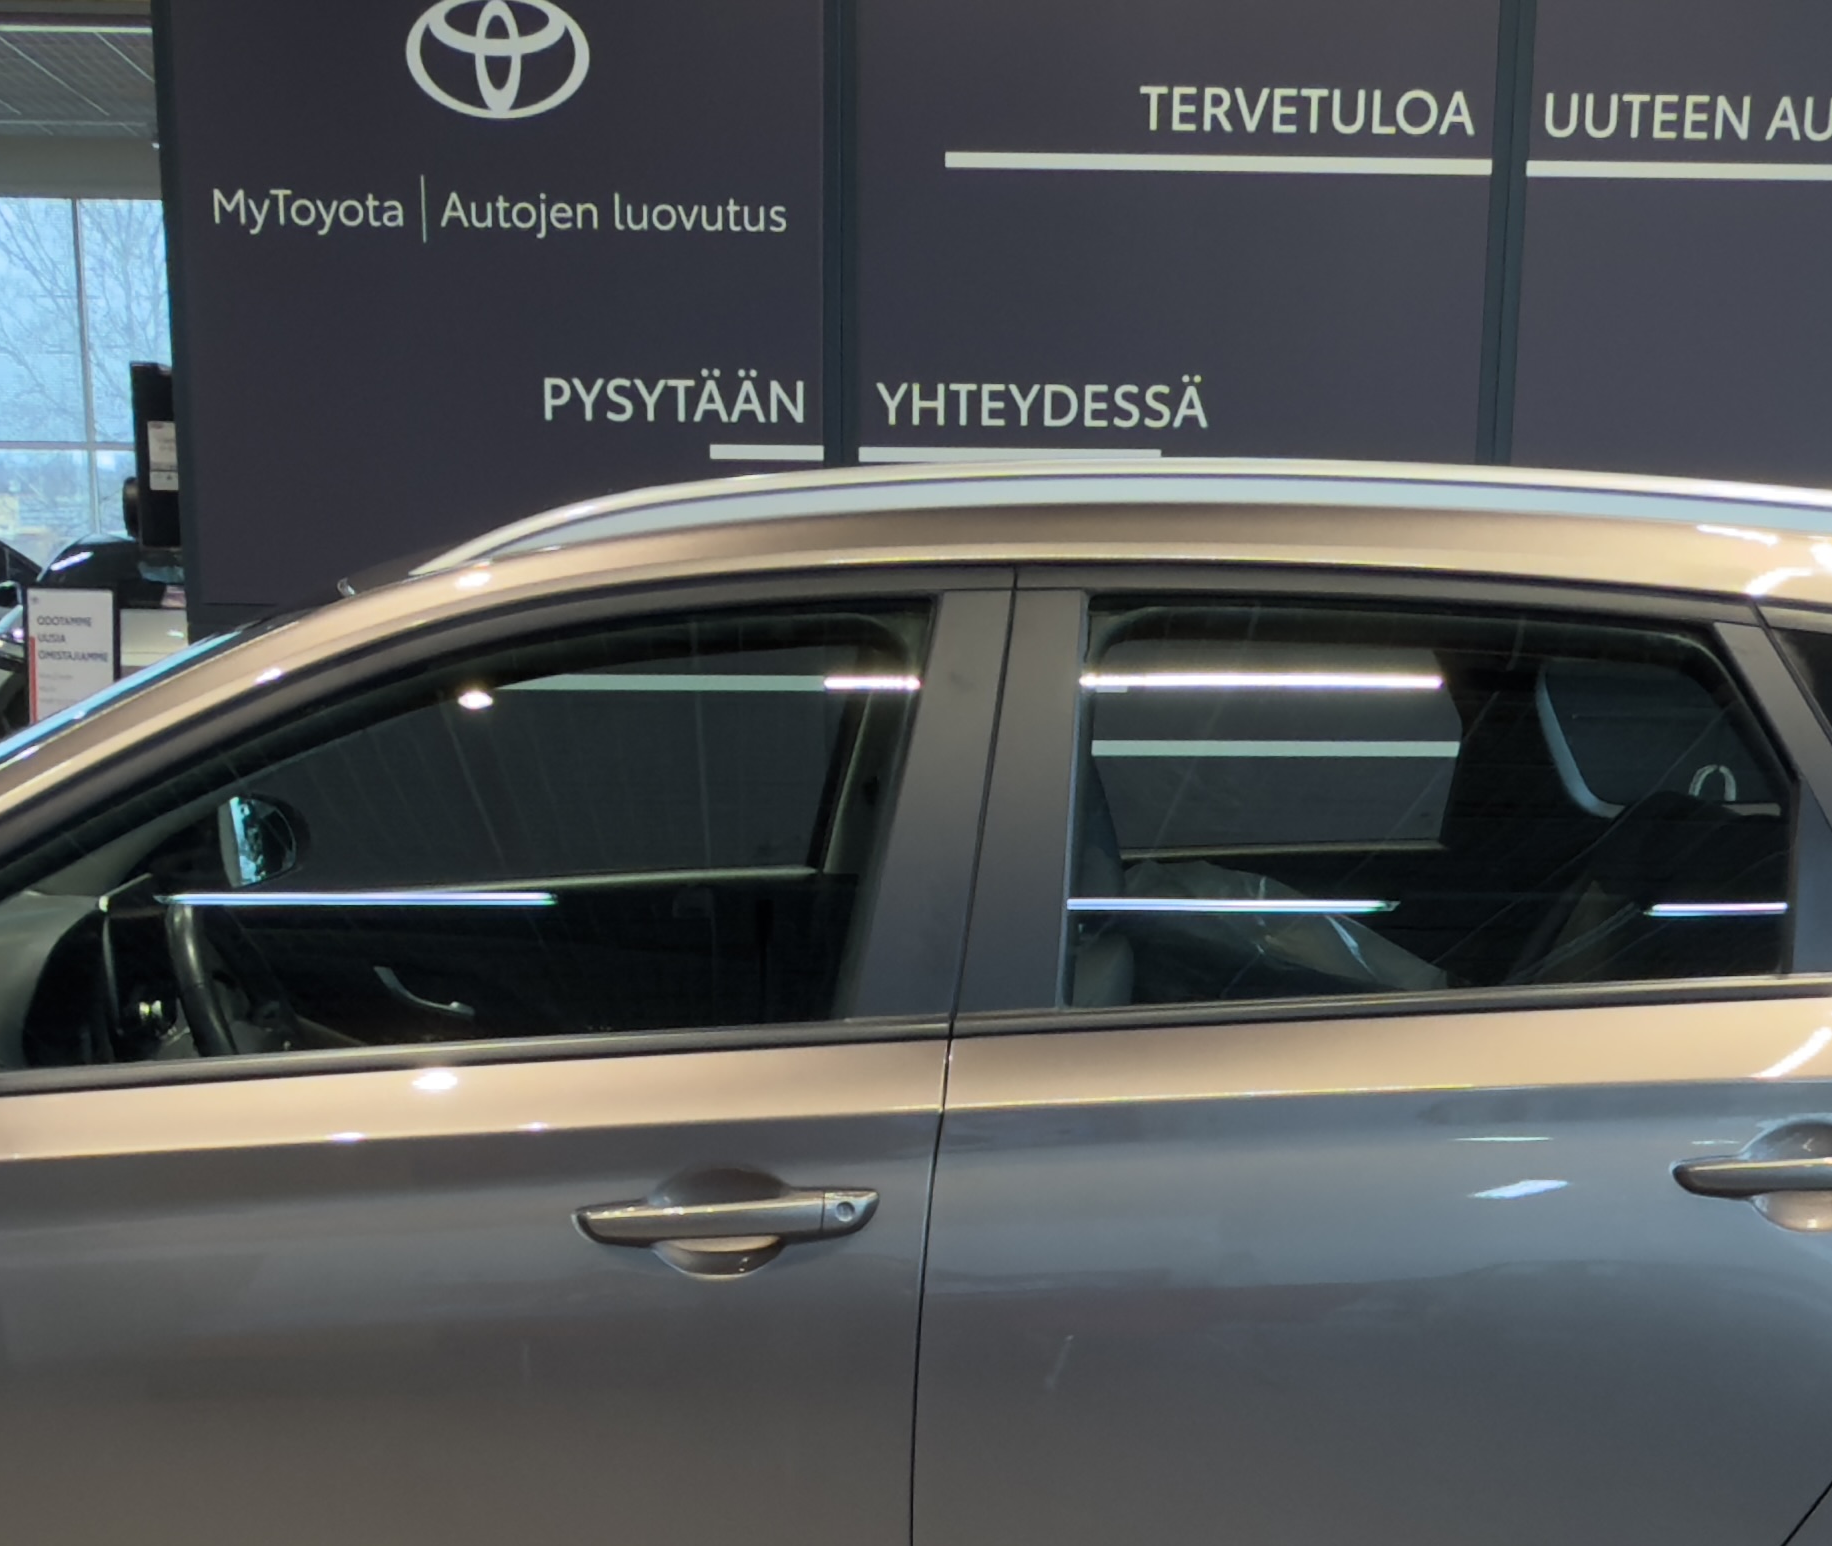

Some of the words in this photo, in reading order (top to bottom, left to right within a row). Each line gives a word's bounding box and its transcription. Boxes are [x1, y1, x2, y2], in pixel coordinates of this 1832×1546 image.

[1138, 84, 1476, 137] TERVETULOA
[1543, 91, 1752, 142] UUTEEN
[211, 187, 405, 237] MyToyota
[439, 190, 600, 240] Autojen
[613, 191, 788, 234] luovutus
[542, 367, 806, 425] PYSYTÄÄN
[875, 373, 1209, 430] YHTEYDESSÄ
[36, 615, 93, 628] ODOTAMME
